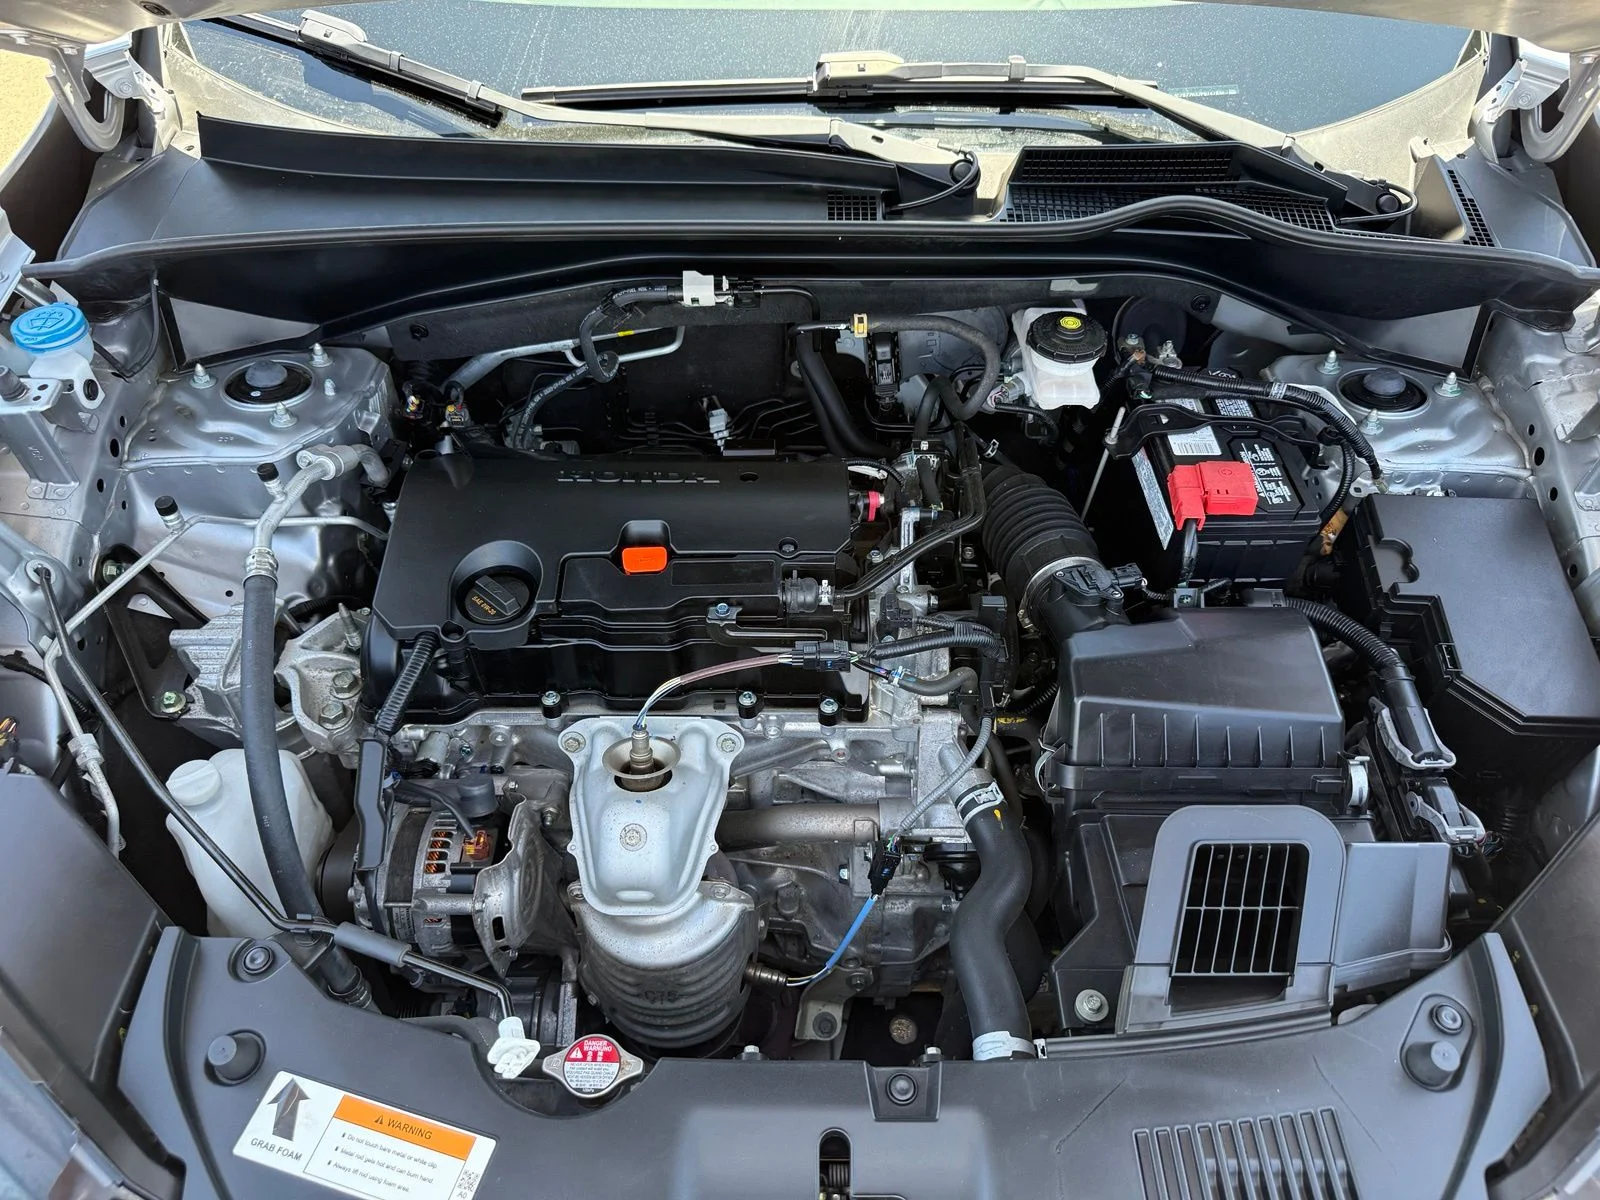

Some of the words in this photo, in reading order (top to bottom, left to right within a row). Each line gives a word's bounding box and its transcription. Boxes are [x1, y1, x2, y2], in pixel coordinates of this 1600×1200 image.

[387, 1118, 433, 1140] WARNING
[250, 1137, 275, 1153] GRAB
[276, 1145, 303, 1161] FOAM
[364, 1140, 379, 1149] touch
[379, 1144, 391, 1153] bare
[391, 1149, 407, 1159] metal
[413, 1157, 427, 1166] white
[333, 1162, 352, 1173] Always
[358, 1170, 369, 1179] rod
[368, 1174, 384, 1185] using
[383, 1177, 398, 1188] foam
[340, 1147, 355, 1157] Metal
[354, 1152, 365, 1161] rod
[363, 1157, 376, 1165] gets
[376, 1159, 386, 1168] hot
[385, 1163, 397, 1172] and
[396, 1167, 407, 1175] can
[406, 1170, 420, 1180] burn
